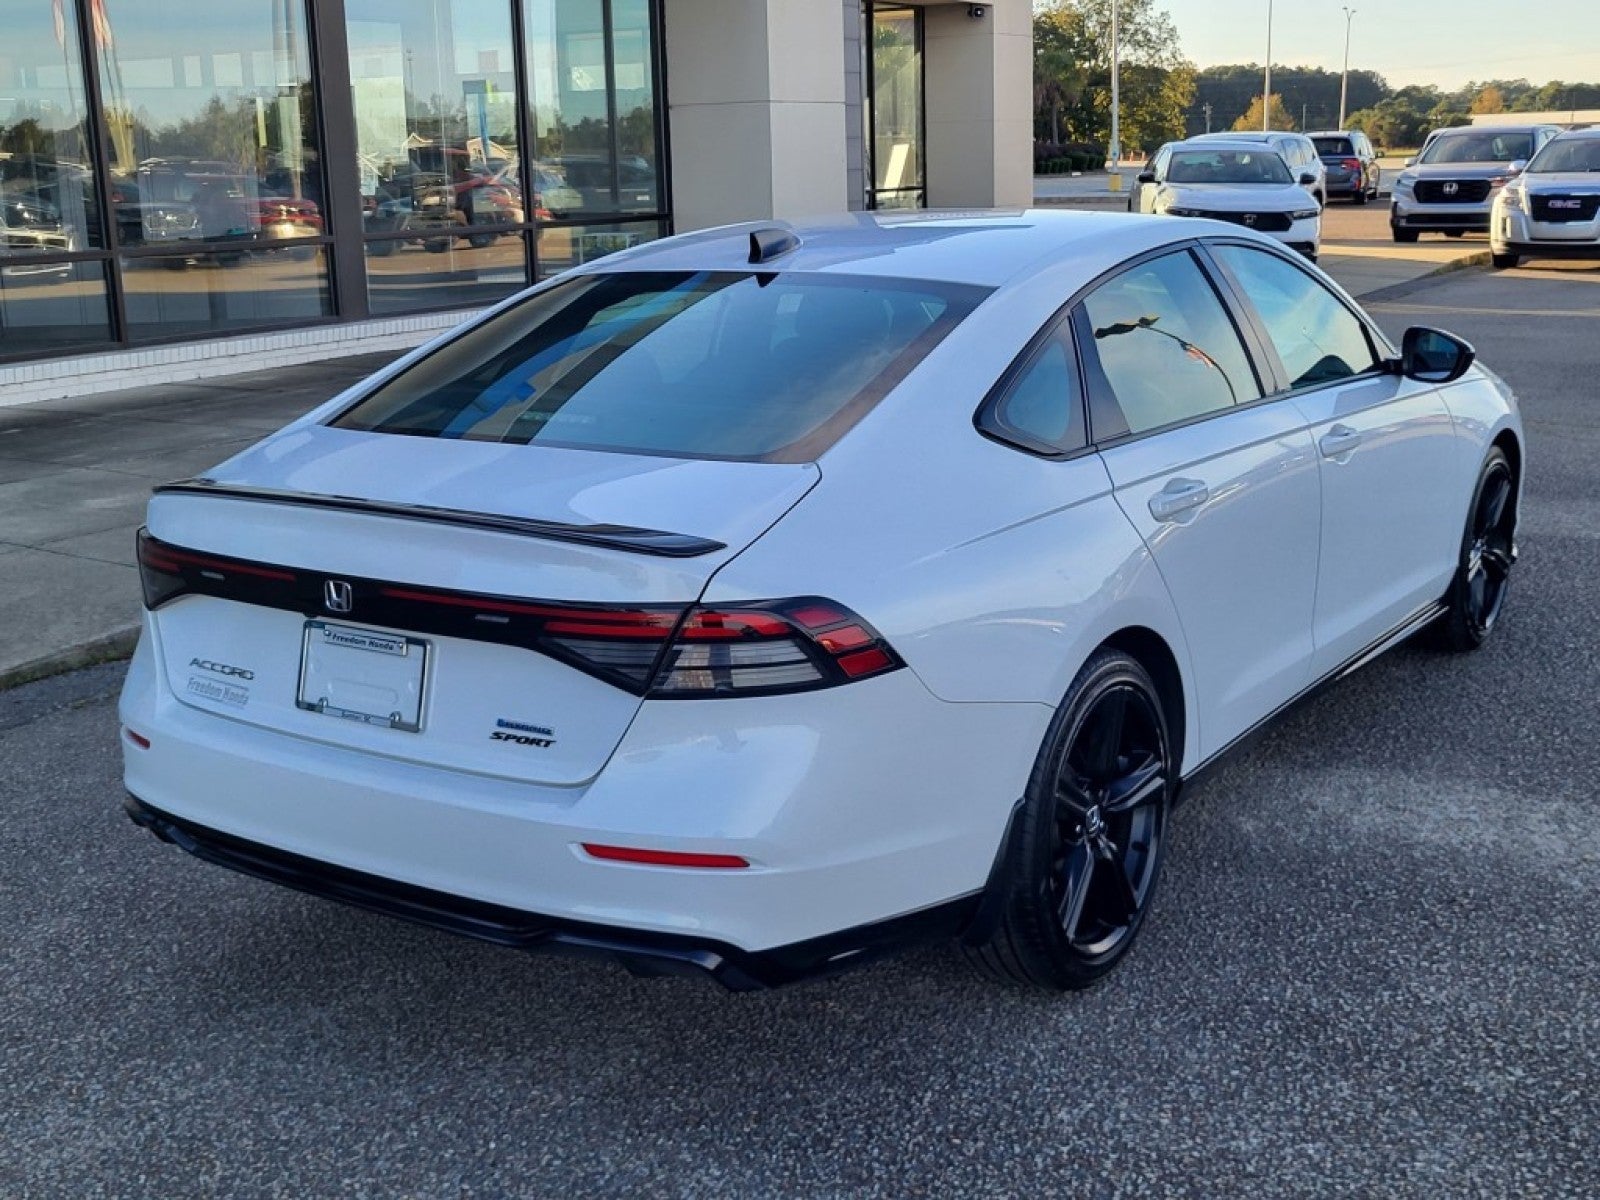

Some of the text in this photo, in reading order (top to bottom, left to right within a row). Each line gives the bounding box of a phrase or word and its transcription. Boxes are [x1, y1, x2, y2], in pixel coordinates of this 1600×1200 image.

[1548, 199, 1581, 209] GMC
[332, 633, 395, 651] Freedom Honda
[189, 657, 255, 681] ACCORD
[489, 731, 557, 748] SPORT
